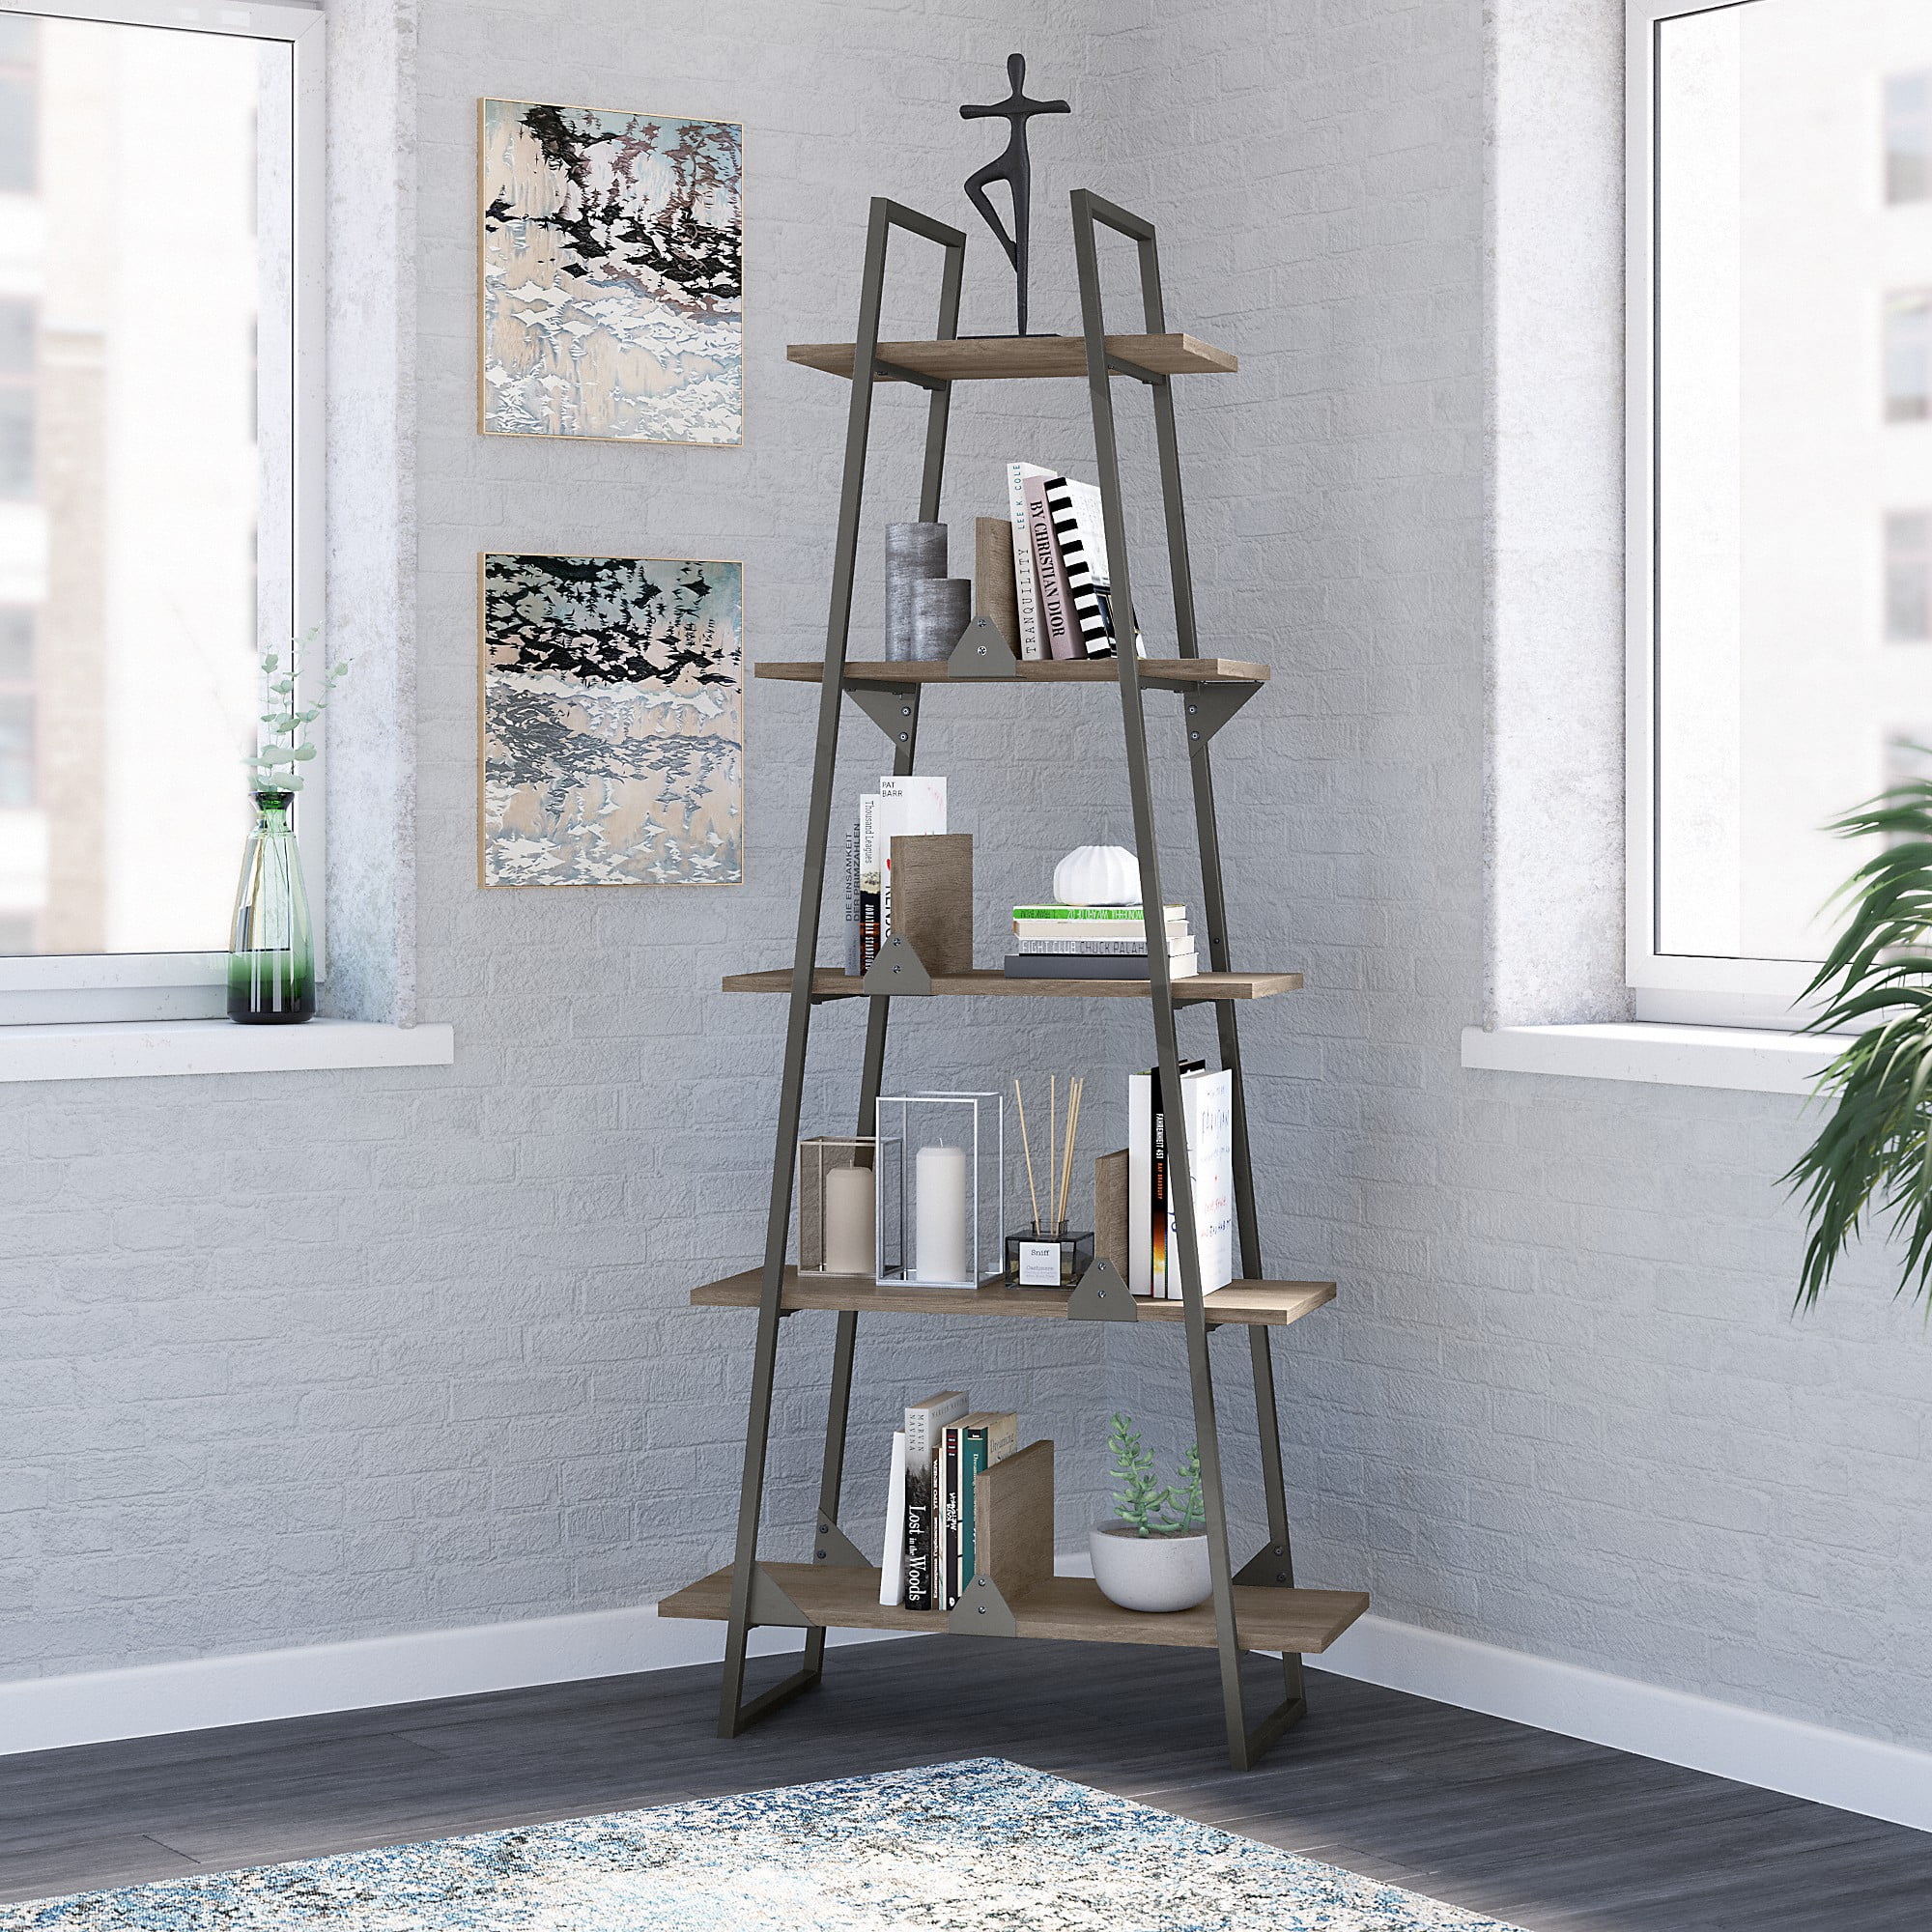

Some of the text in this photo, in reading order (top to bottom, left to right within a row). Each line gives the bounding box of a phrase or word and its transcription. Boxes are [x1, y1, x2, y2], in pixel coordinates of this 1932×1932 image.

[1012, 465, 1022, 491] COLE
[1016, 511, 1025, 530] LEE
[1030, 500, 1065, 638] BY CHRISTIAN DIOR
[1019, 549, 1037, 654] TRANQUILITY
[882, 789, 903, 798] BARR
[863, 800, 874, 864] Thousand Leagues
[1022, 941, 1148, 953] FIGHT CLUB CHUCK PALAH
[1155, 1113, 1164, 1148] FAHRENHEIT
[909, 1505, 926, 1534] Lost
[909, 1554, 926, 1602] Woods
